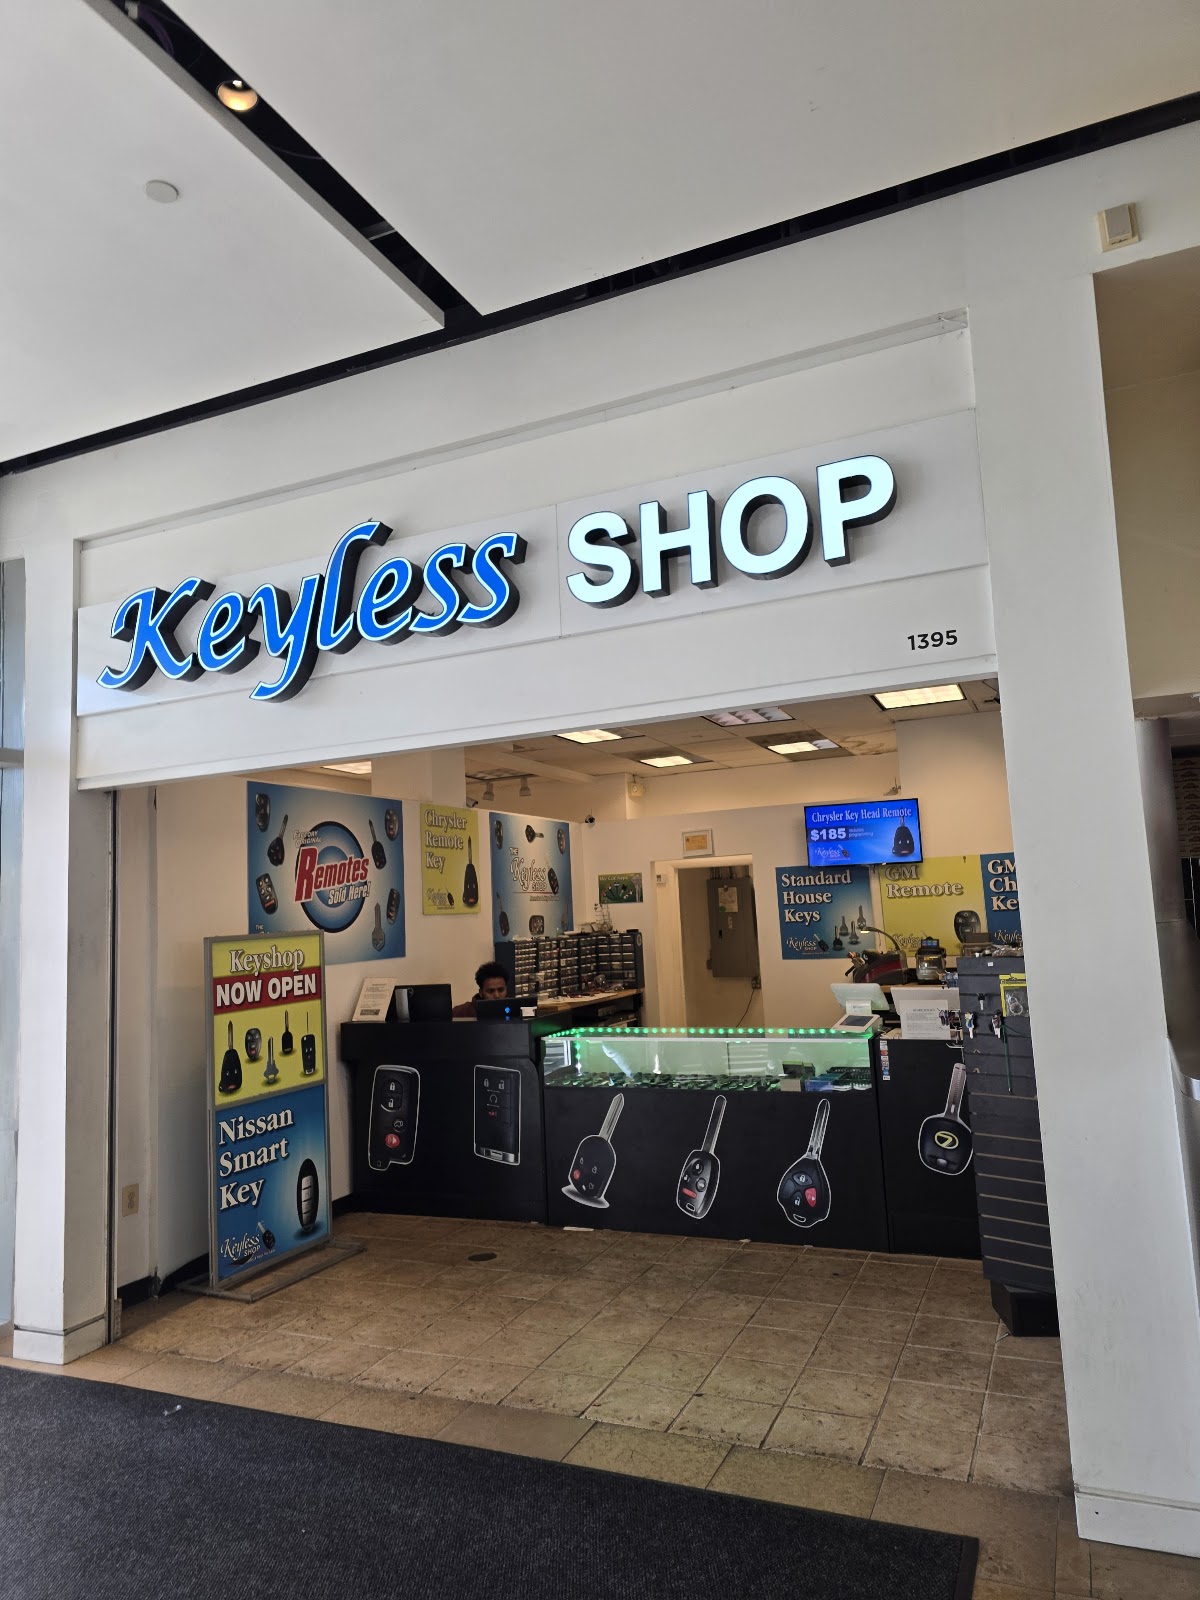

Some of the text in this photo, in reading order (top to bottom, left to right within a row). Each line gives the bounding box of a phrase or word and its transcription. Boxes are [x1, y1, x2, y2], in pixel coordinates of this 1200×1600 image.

[96, 454, 897, 703] Keyless SHOP
[907, 629, 958, 651] 1395
[425, 809, 467, 832] Chrysler
[811, 807, 912, 825] Chrysler Key Head Remote
[425, 830, 464, 849] Remote
[810, 827, 847, 842] $185
[294, 846, 370, 902] Remotes
[426, 852, 445, 874] Key
[510, 857, 547, 891] Keyless
[885, 864, 919, 880] GM
[781, 870, 852, 887] Standard
[989, 876, 1018, 893] Ch
[328, 881, 371, 905] Sold Here!
[783, 891, 832, 905] House
[886, 882, 964, 899] Remote
[991, 896, 1020, 911] Ke
[784, 909, 821, 926] Keys
[230, 945, 304, 977] Keyshop
[216, 973, 316, 1007] NOW OPEN
[218, 1109, 294, 1145] Nissan
[219, 1137, 289, 1177] Smart
[219, 1179, 265, 1211] Key
[244, 1244, 261, 1257] SHOP
